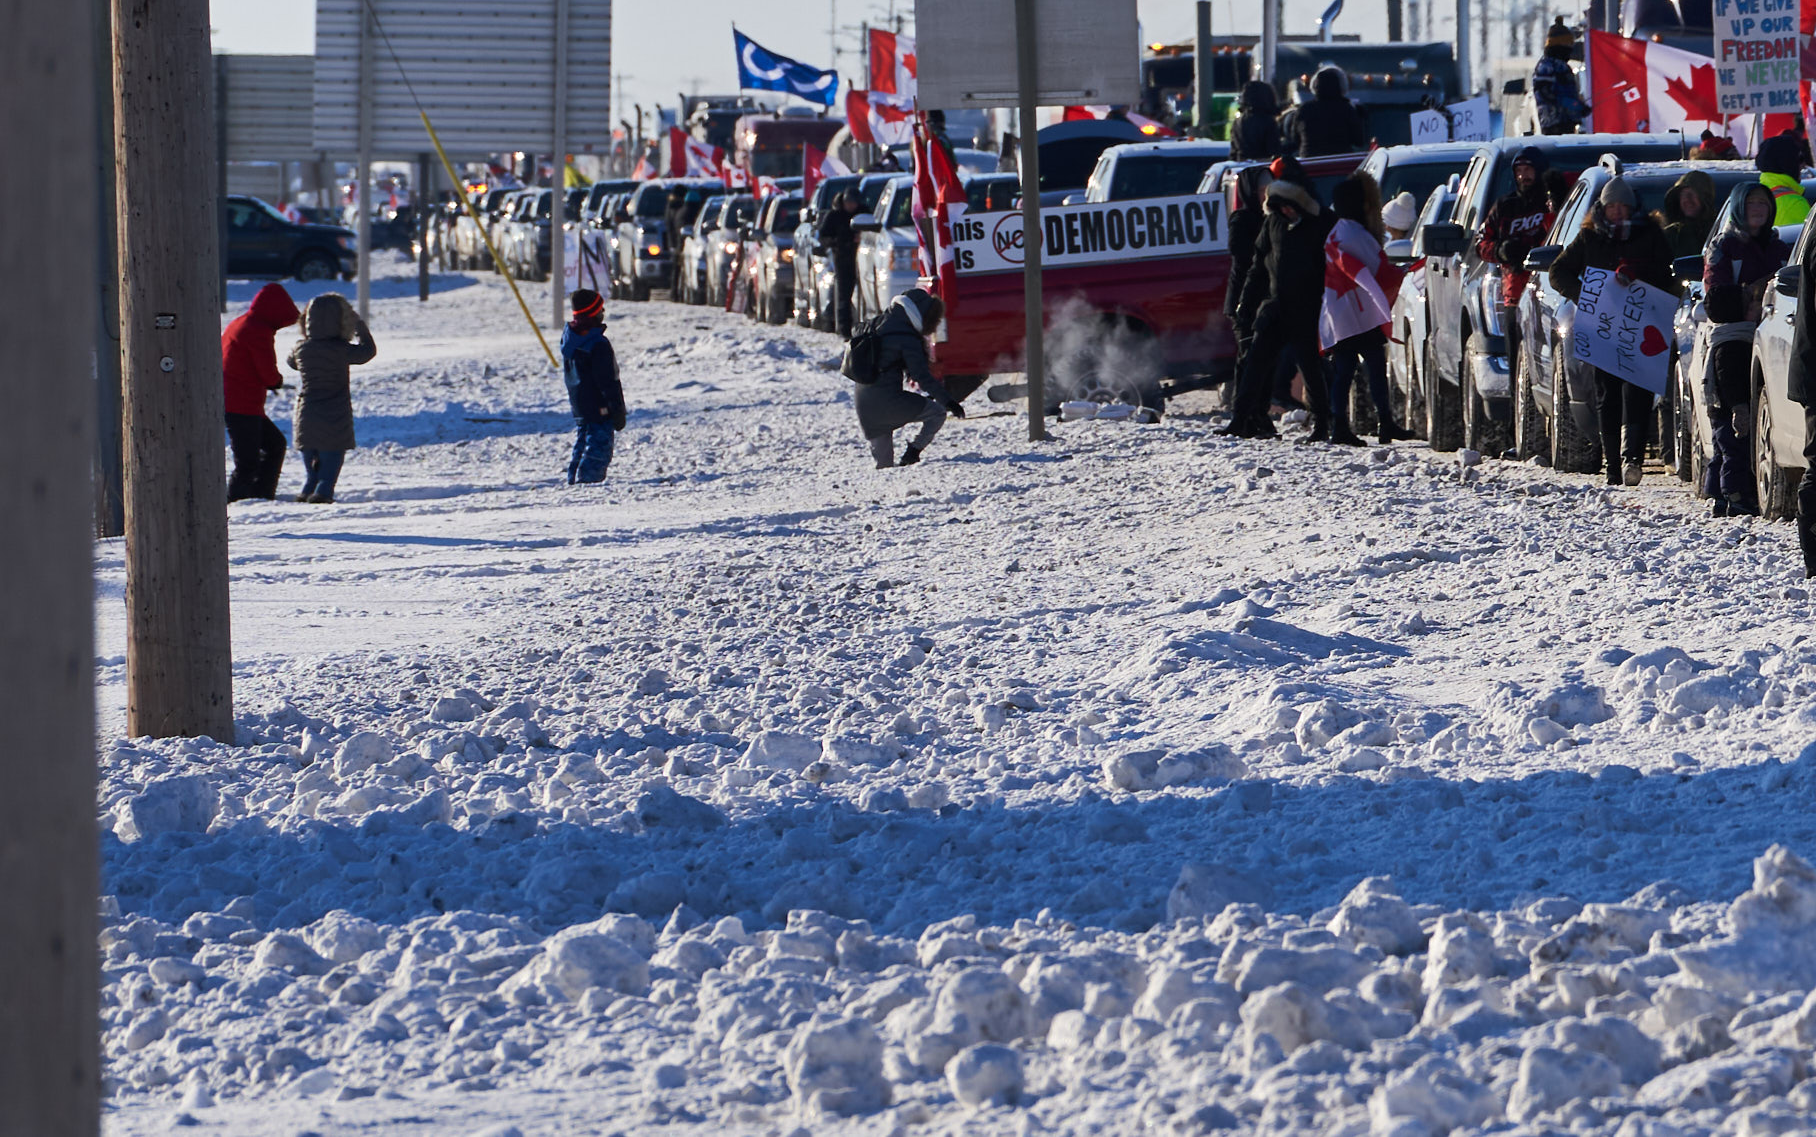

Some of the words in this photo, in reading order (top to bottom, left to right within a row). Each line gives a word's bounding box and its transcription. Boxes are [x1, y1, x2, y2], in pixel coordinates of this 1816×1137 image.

[1730, 18, 1755, 36] UP
[1760, 16, 1794, 34] OUR
[1722, 37, 1797, 62] FREEDOM
[1718, 68, 1736, 86] WE
[1745, 60, 1799, 87] NEVER
[1721, 94, 1746, 110] GET
[1749, 92, 1764, 108] IT
[1767, 89, 1799, 107] BACK
[1417, 116, 1440, 136] NO
[997, 229, 1024, 250] NO
[1045, 199, 1222, 257] DEMOCRACY
[1509, 212, 1545, 236] FXR
[953, 246, 975, 270] Is
[1577, 269, 1608, 316] BLESS
[1596, 312, 1616, 341] OUR
[1616, 282, 1647, 374] TRUCKERS
[1575, 331, 1592, 358] GOD
